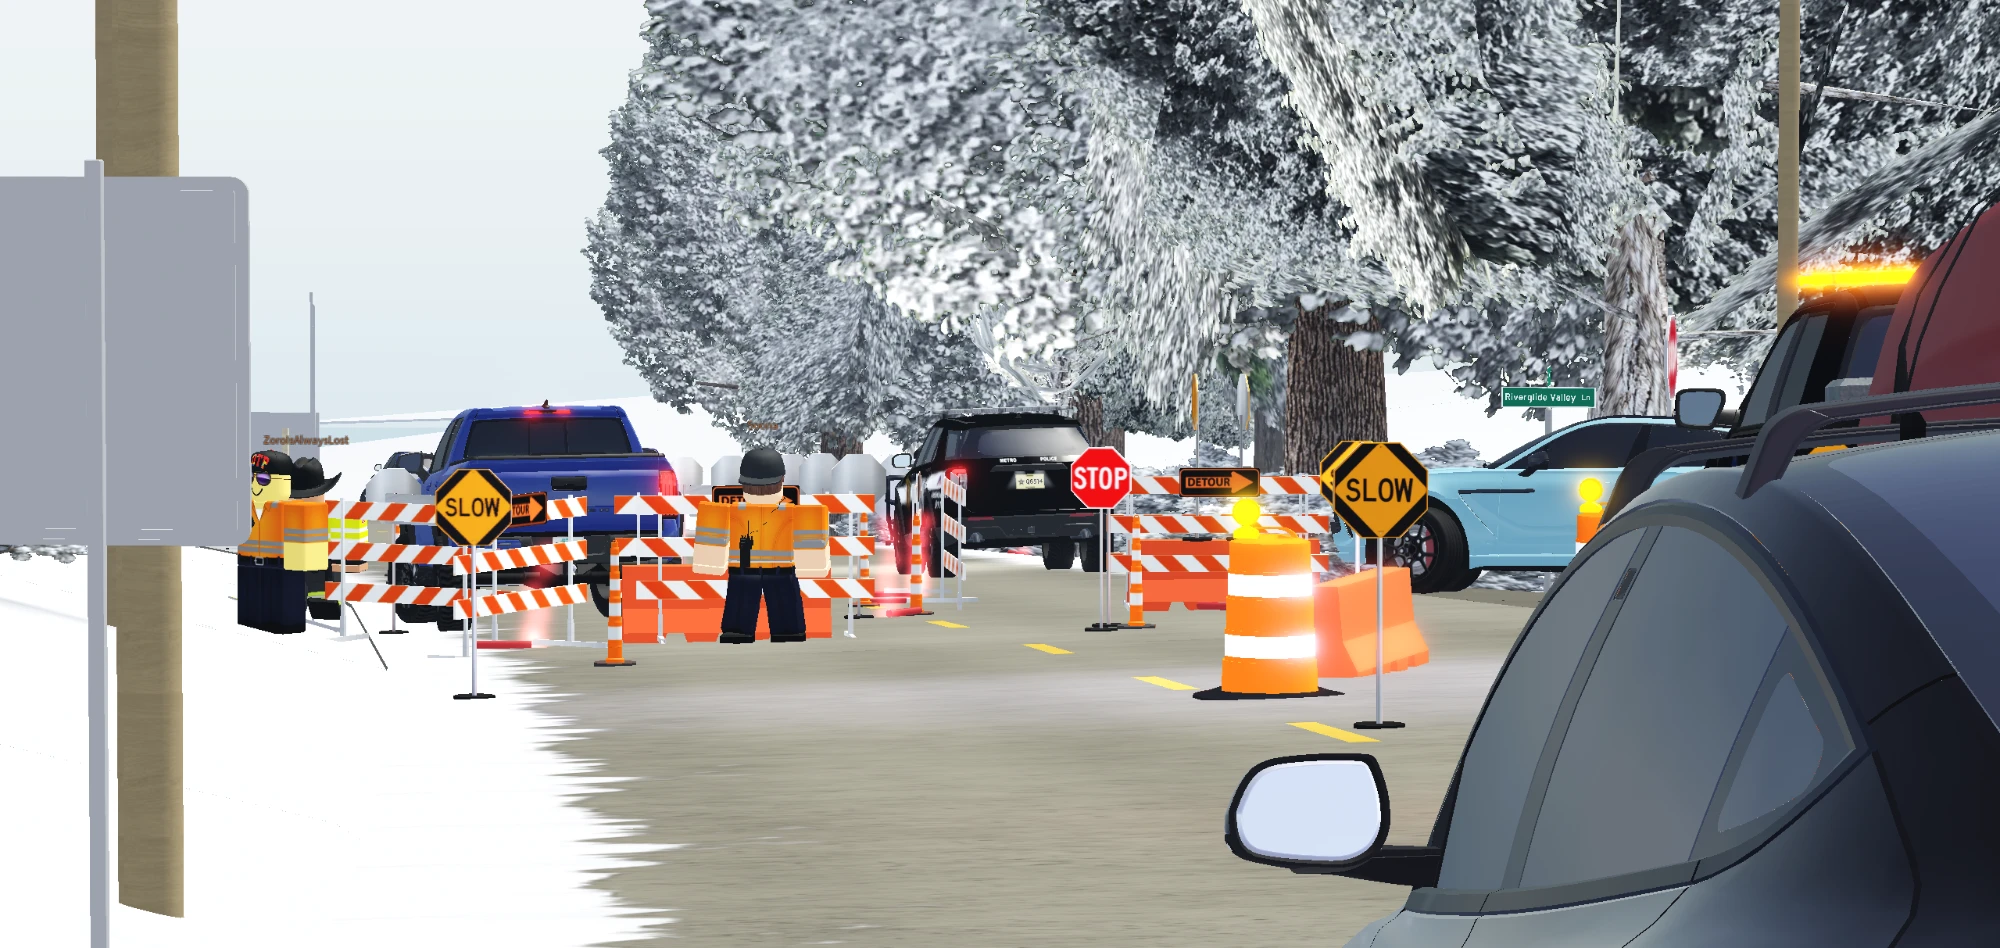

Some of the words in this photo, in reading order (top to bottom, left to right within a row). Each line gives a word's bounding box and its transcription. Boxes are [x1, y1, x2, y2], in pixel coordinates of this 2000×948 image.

[1504, 392, 1548, 404] Riverglide
[1550, 393, 1576, 404] Valley
[1073, 466, 1128, 490] STOP
[1187, 477, 1231, 487] DETOUR
[1345, 477, 1414, 503] SLOW
[445, 497, 500, 517] SLOW
[512, 503, 530, 517] TOUR
